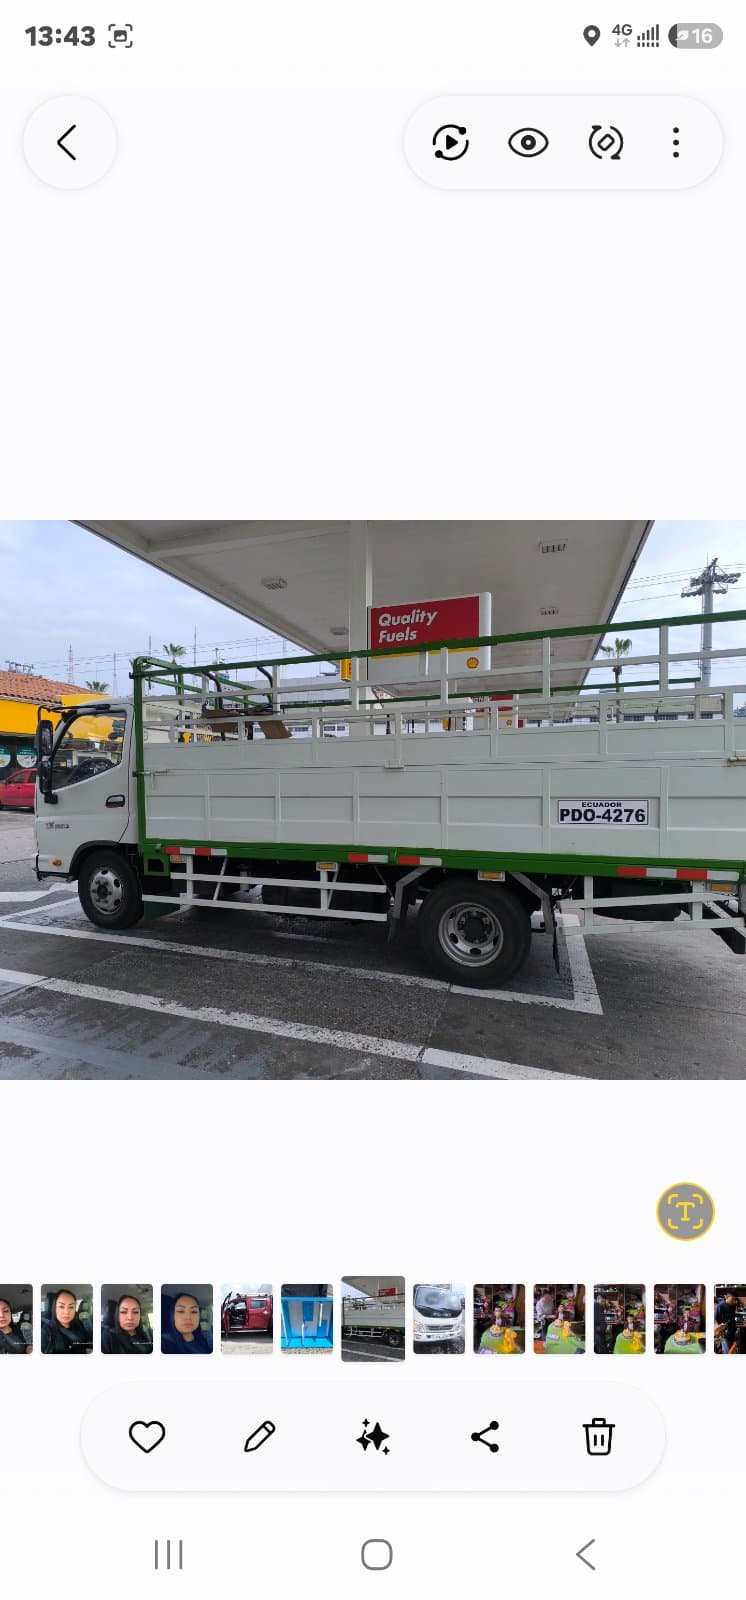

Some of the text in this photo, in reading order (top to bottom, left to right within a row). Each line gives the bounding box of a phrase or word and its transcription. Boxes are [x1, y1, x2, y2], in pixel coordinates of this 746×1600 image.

[25, 25, 96, 47] 13:43
[611, 23, 633, 37] 4G
[691, 28, 713, 45] 16
[378, 609, 438, 627] Quality
[378, 627, 418, 643] Fuels
[559, 808, 646, 823] PDO-4276
